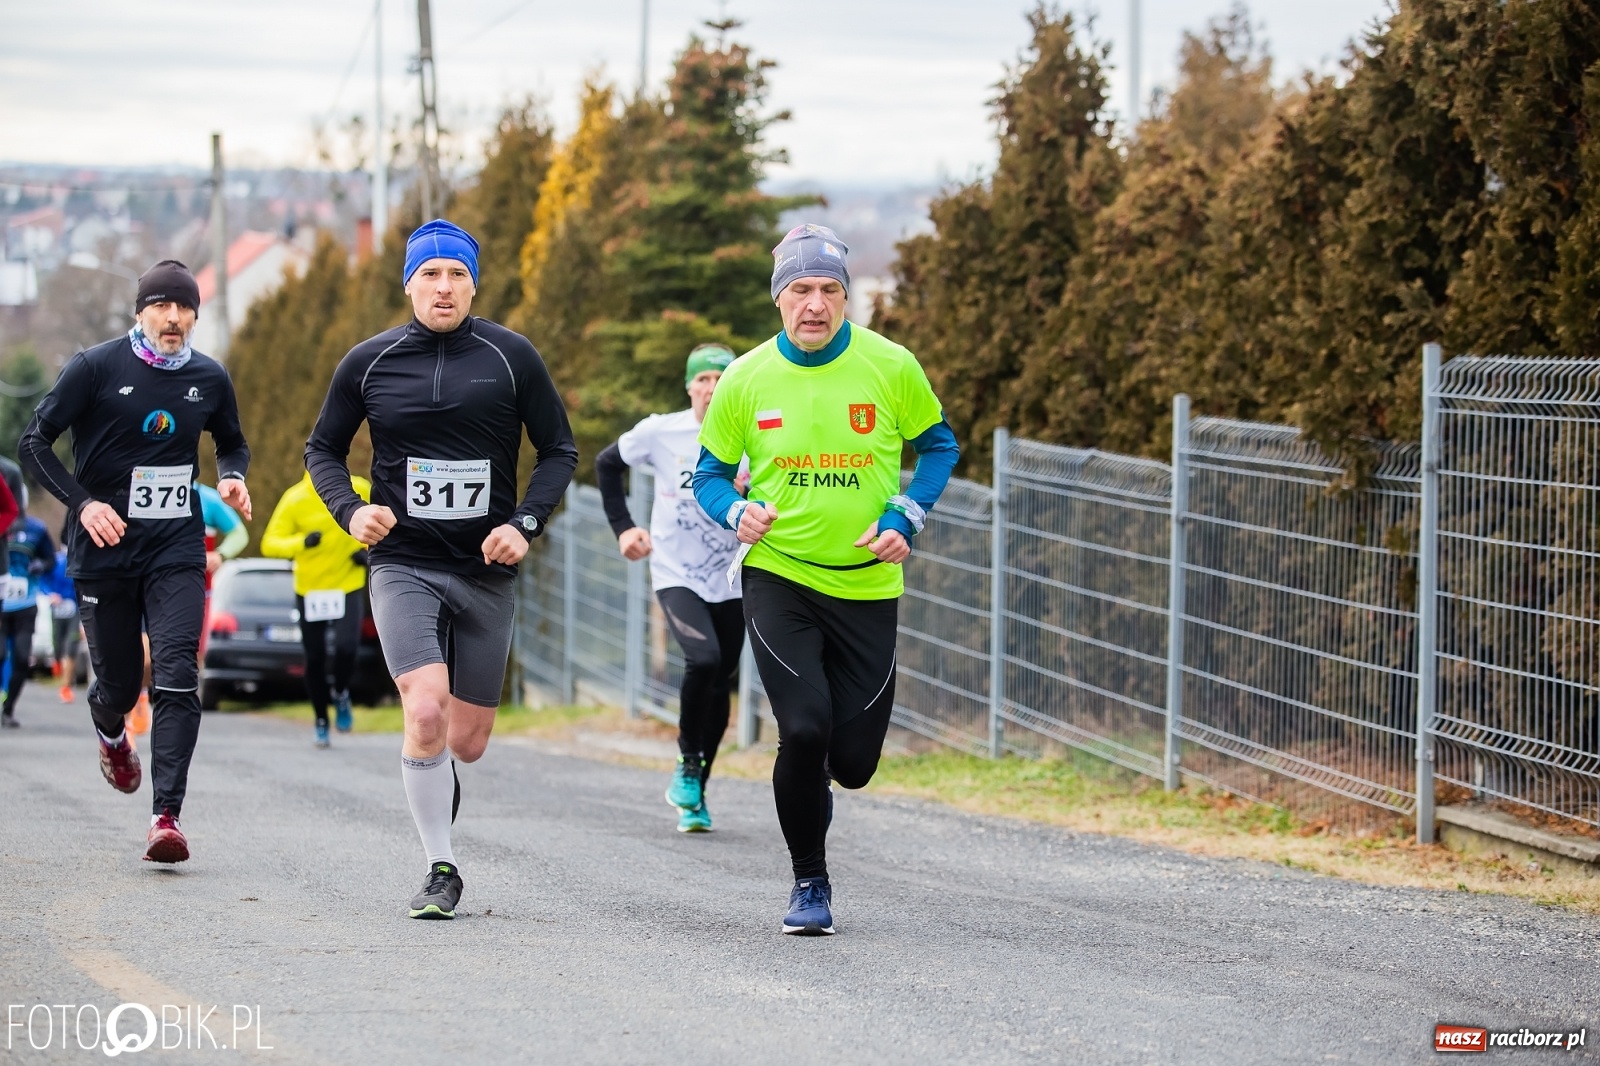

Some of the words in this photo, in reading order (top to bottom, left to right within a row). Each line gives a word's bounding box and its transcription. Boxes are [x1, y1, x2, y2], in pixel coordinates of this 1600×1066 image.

[118, 386, 134, 395] 4F
[773, 454, 815, 469] ONA
[820, 453, 874, 468] BIEGA
[788, 472, 809, 487] ZE
[814, 473, 860, 489] MNĄ
[134, 484, 188, 509] 379
[412, 480, 485, 508] 317
